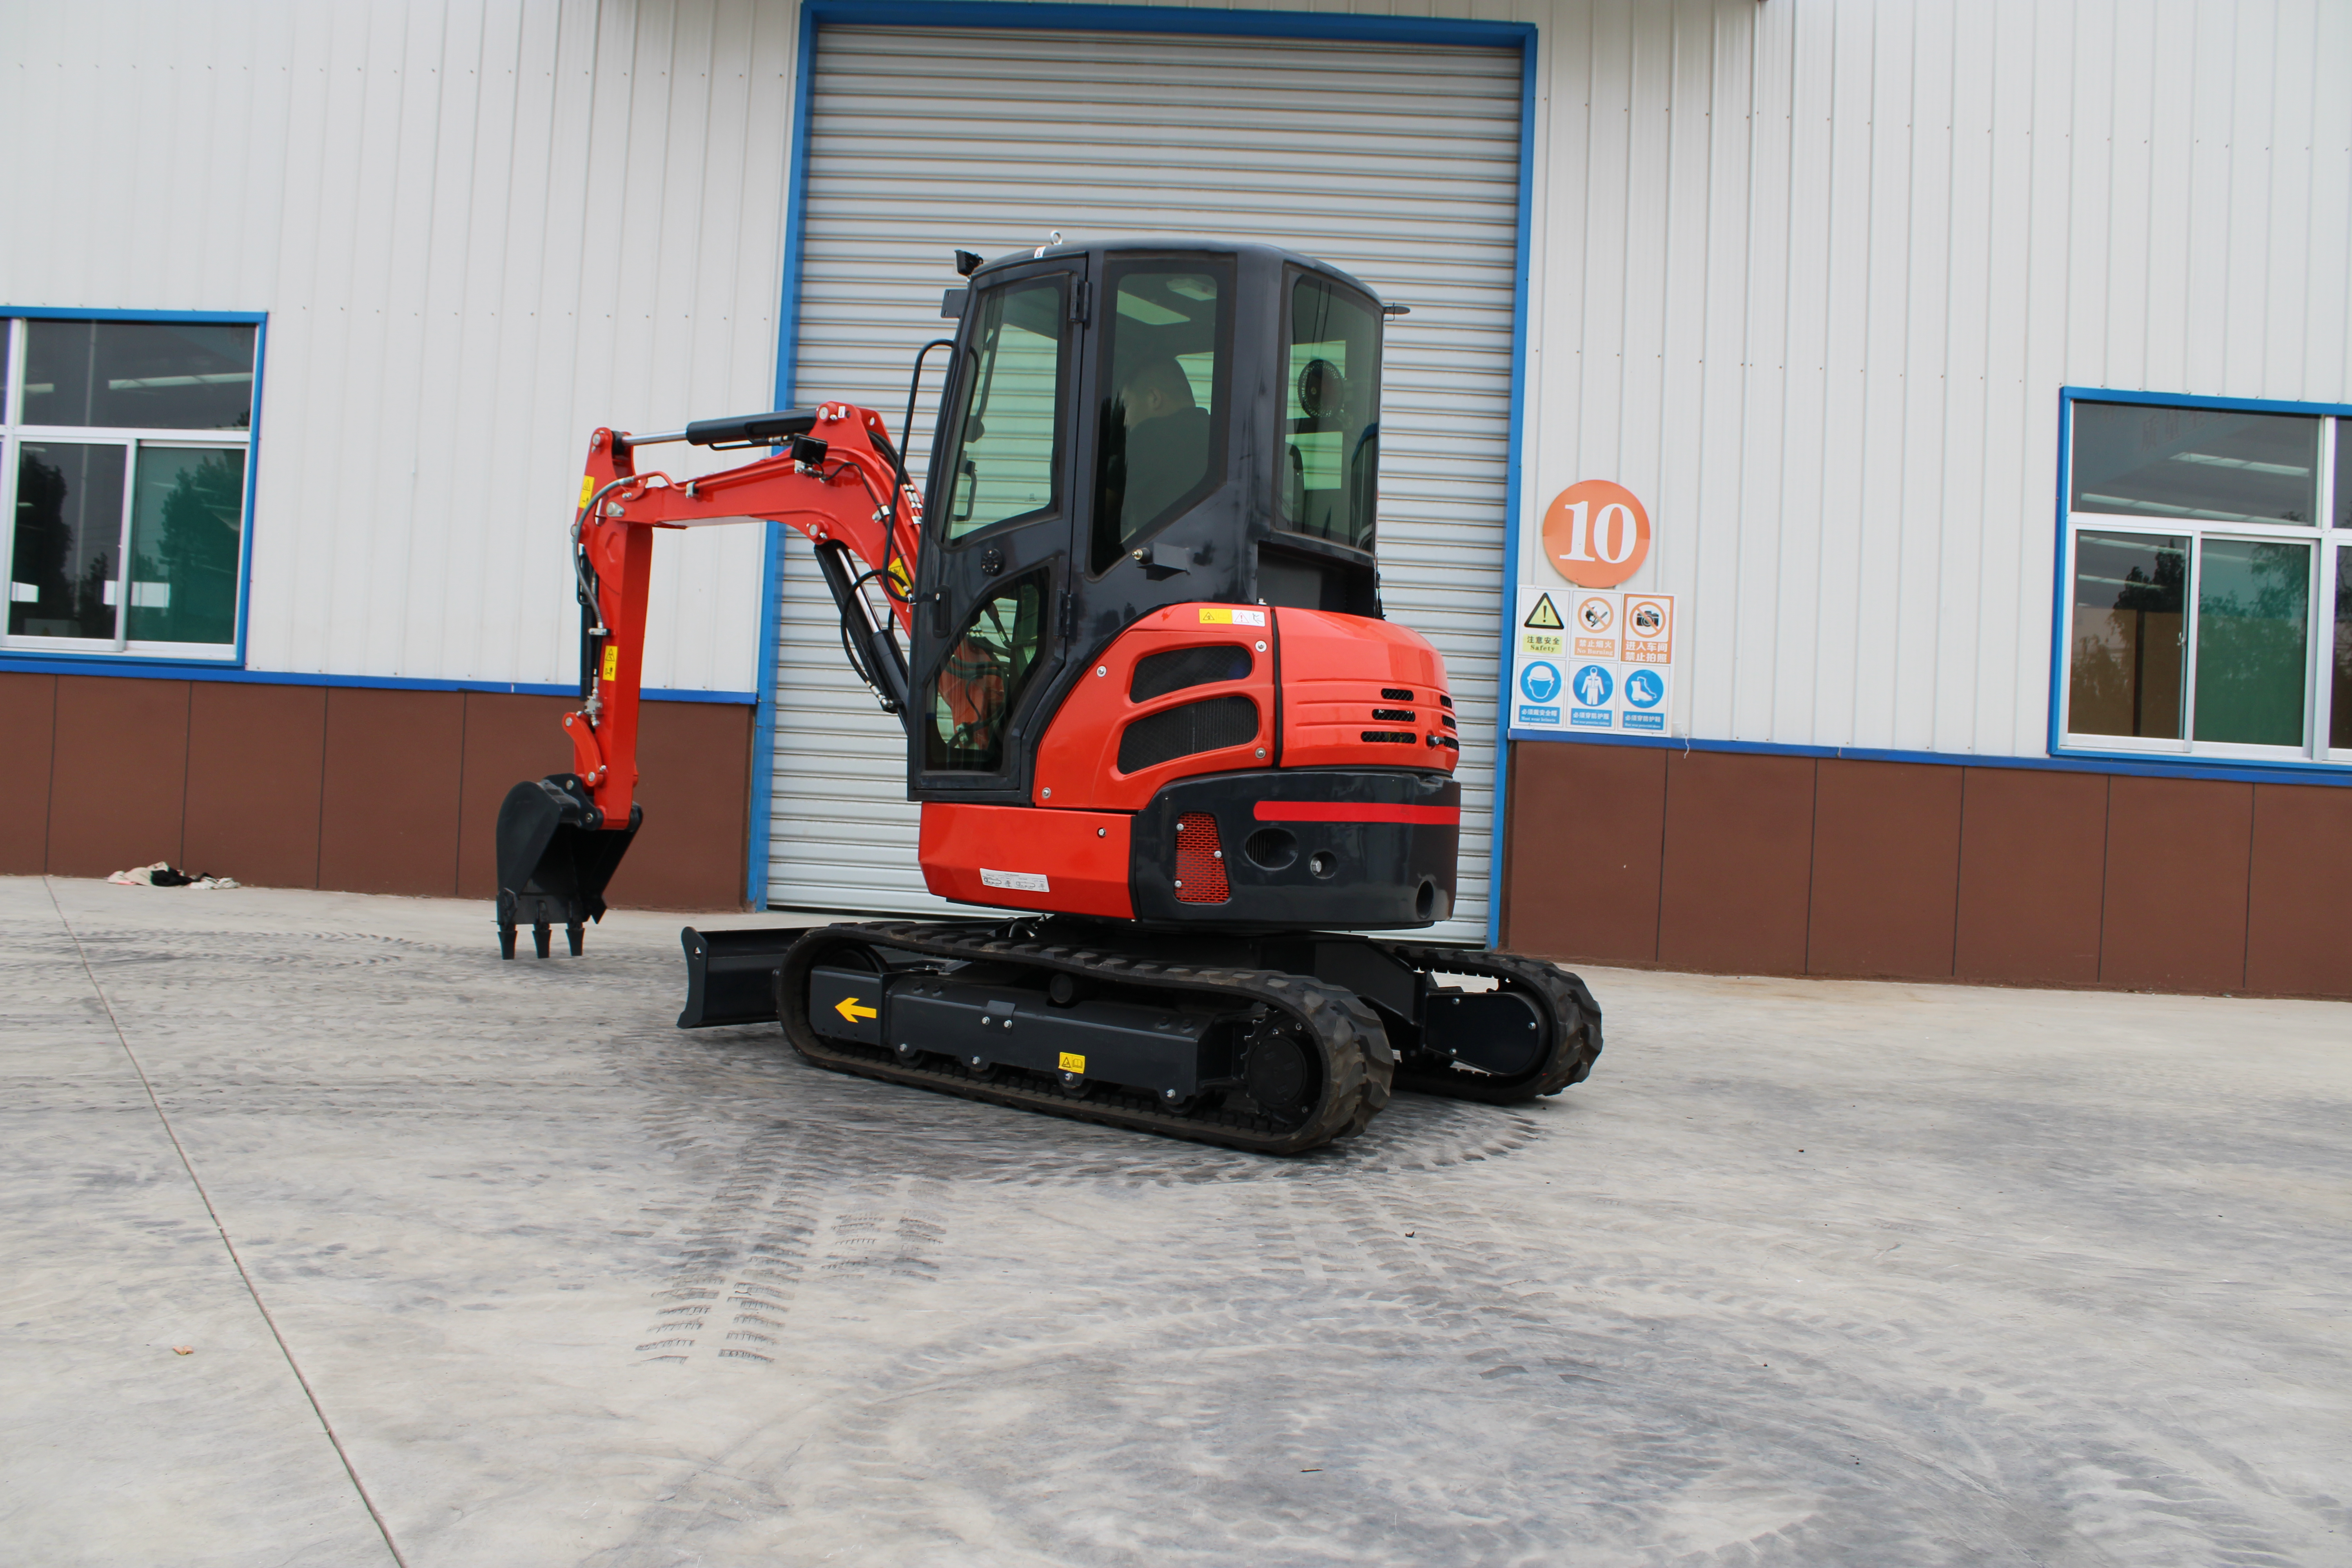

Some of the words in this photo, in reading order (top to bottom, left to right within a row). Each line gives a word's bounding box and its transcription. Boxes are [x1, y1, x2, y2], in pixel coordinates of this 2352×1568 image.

[1559, 501, 1637, 564] 10
[1527, 635, 1559, 645] 注意安全
[1579, 639, 1612, 648] 禁止烟火
[1626, 641, 1668, 652] 进入车间
[1625, 652, 1667, 662] 禁止拍照
